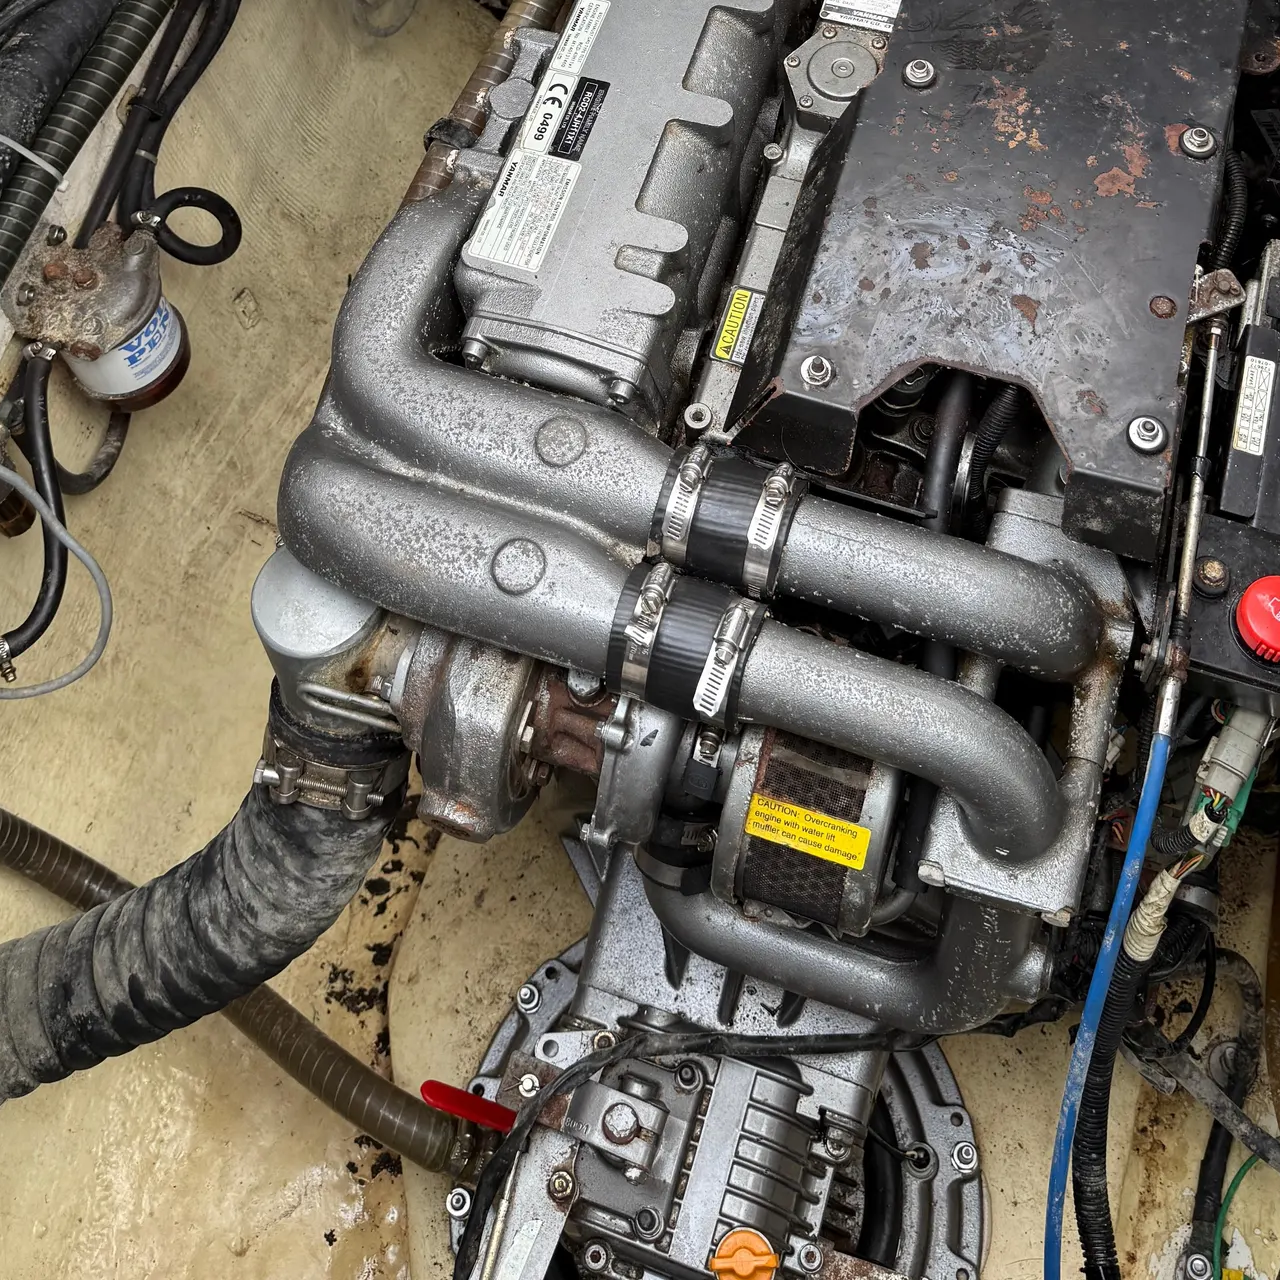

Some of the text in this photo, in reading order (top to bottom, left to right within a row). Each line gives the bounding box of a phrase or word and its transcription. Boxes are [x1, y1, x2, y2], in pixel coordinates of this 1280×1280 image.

[570, 7, 585, 32] YANMAR
[533, 113, 553, 141] 0499
[498, 161, 519, 198] YANMAR
[117, 304, 165, 353] VOL
[123, 306, 170, 368] PEN
[722, 293, 748, 344] CAUTION
[752, 820, 780, 835] muffler
[781, 830, 797, 841] can
[798, 836, 823, 849] cause
[754, 810, 836, 842] engine with water lift
[757, 798, 858, 839] CAUTION: Overcranking
